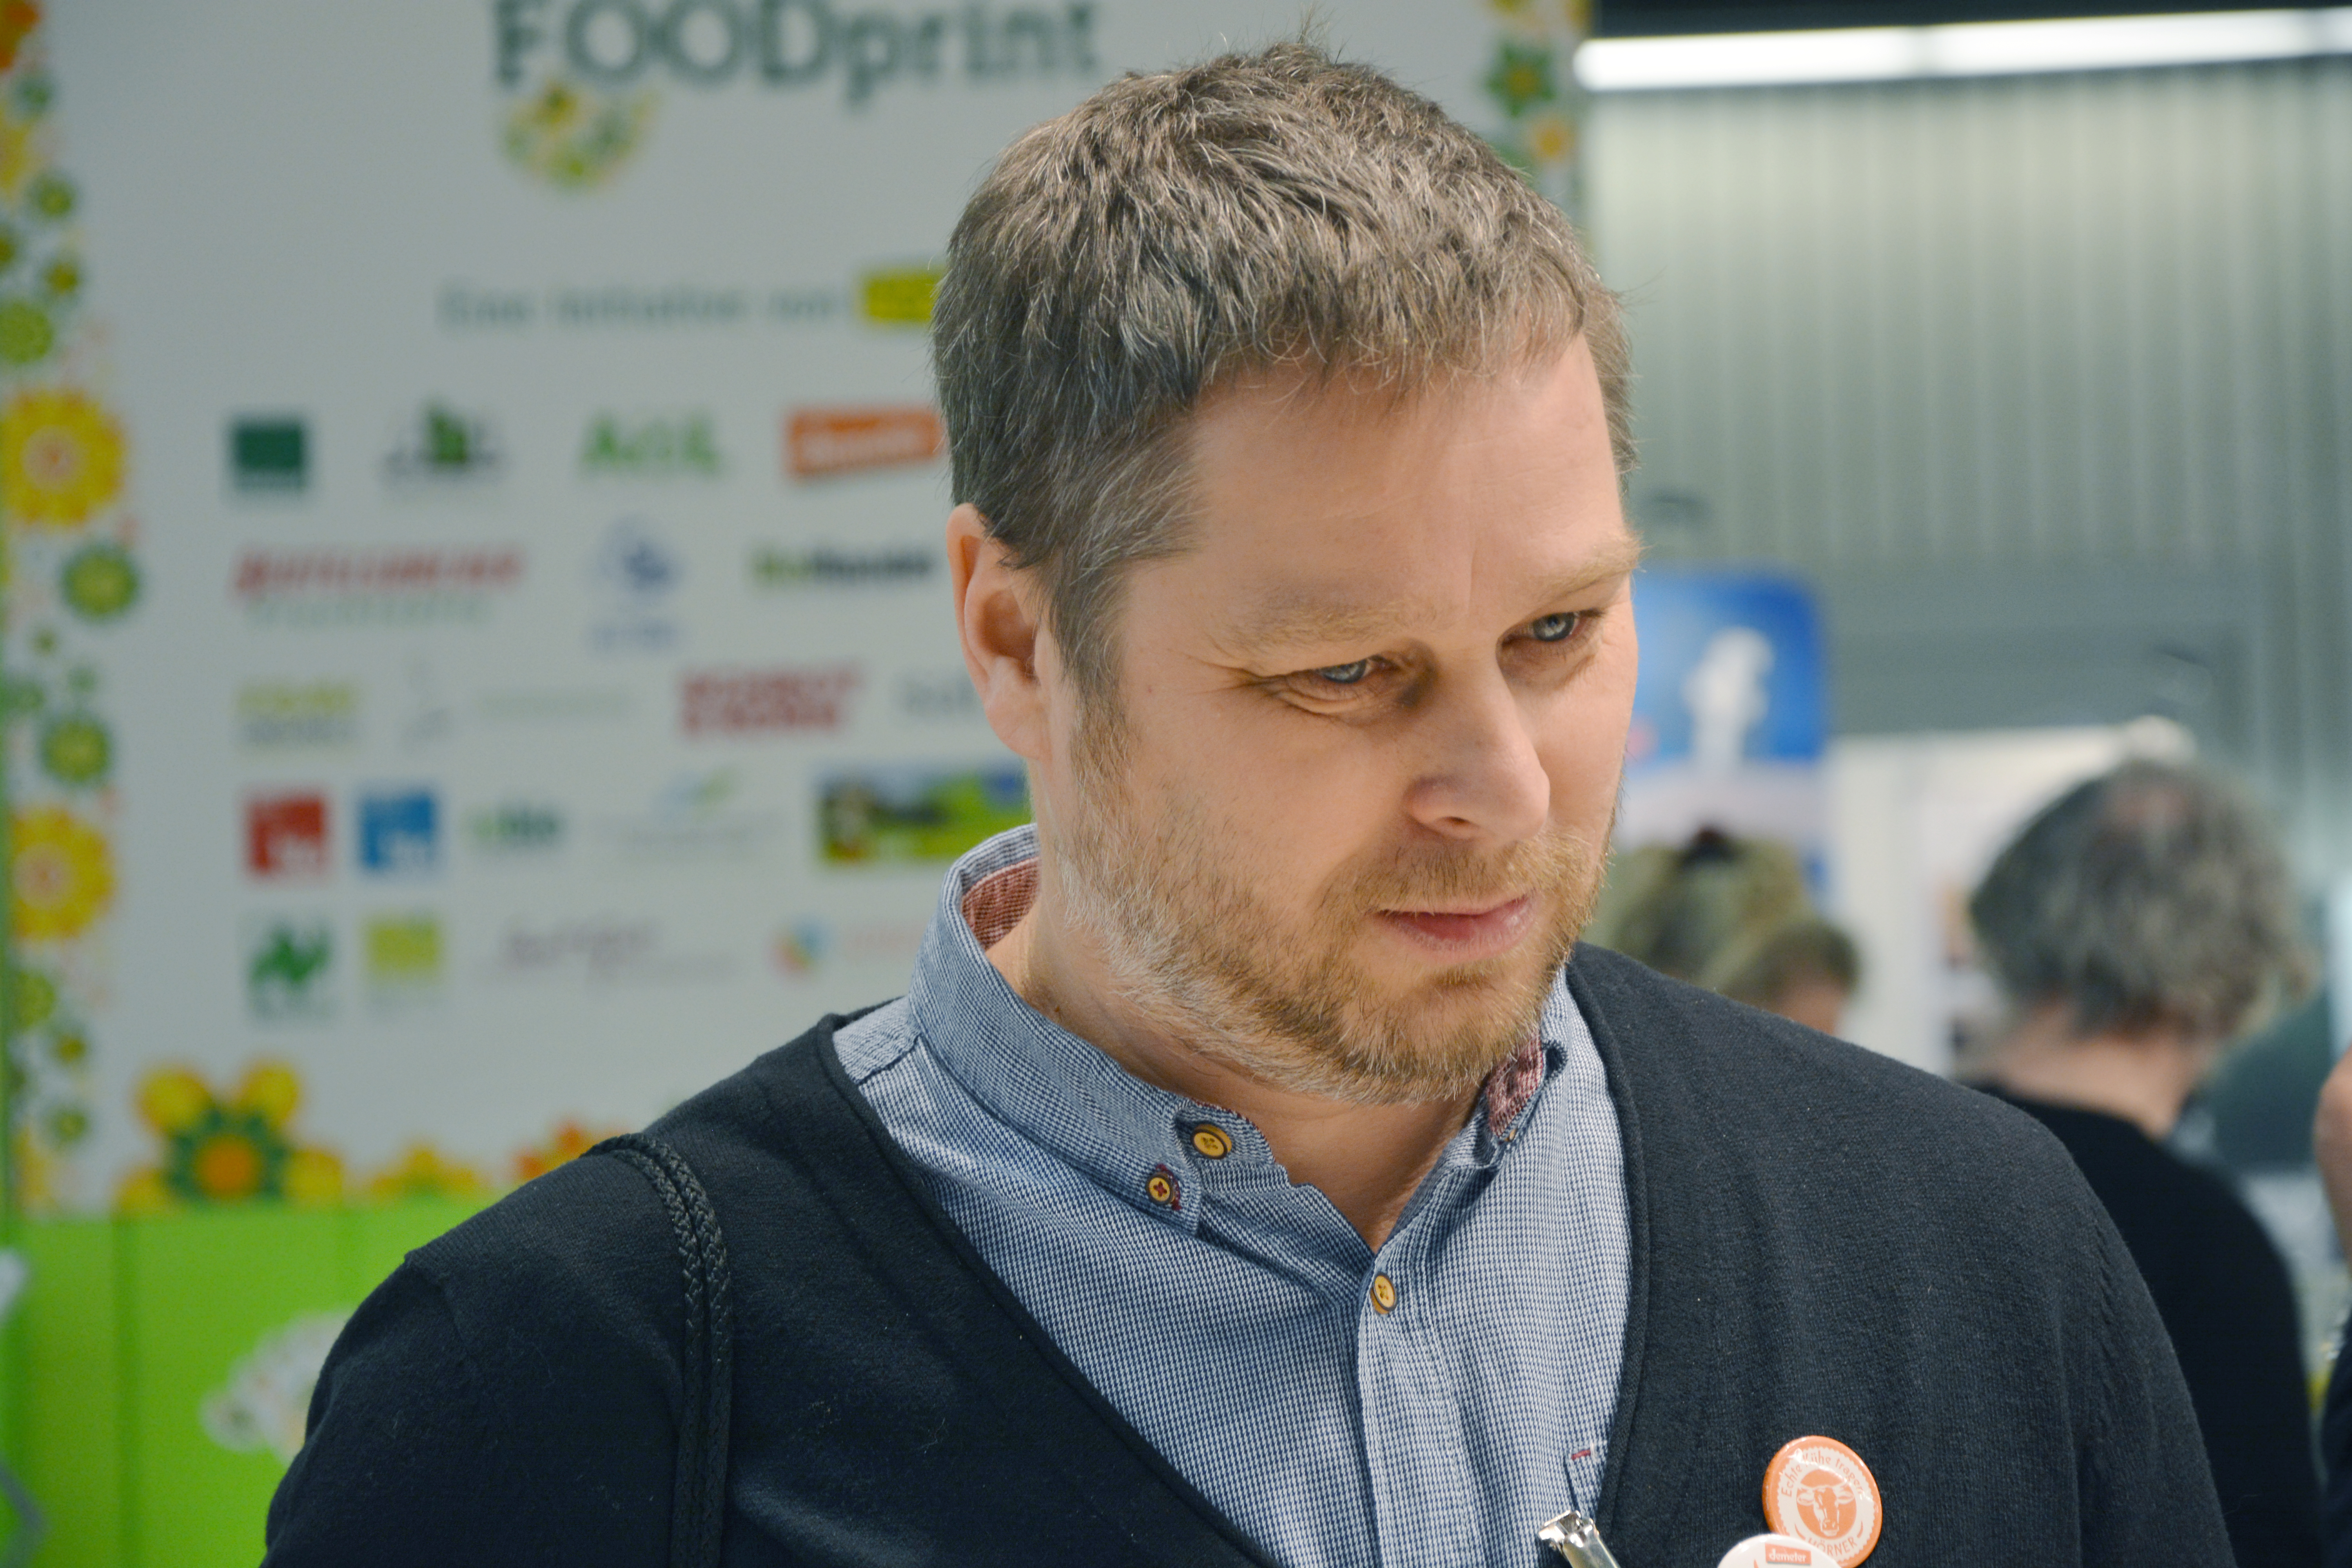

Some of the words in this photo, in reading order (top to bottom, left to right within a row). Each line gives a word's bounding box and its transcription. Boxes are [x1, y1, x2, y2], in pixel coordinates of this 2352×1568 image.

[495, 0, 1097, 112] FOODprint
[1781, 1464, 1802, 1497] Echte
[1835, 1458, 1863, 1494] tragen
[1768, 1548, 1806, 1562] demeter
